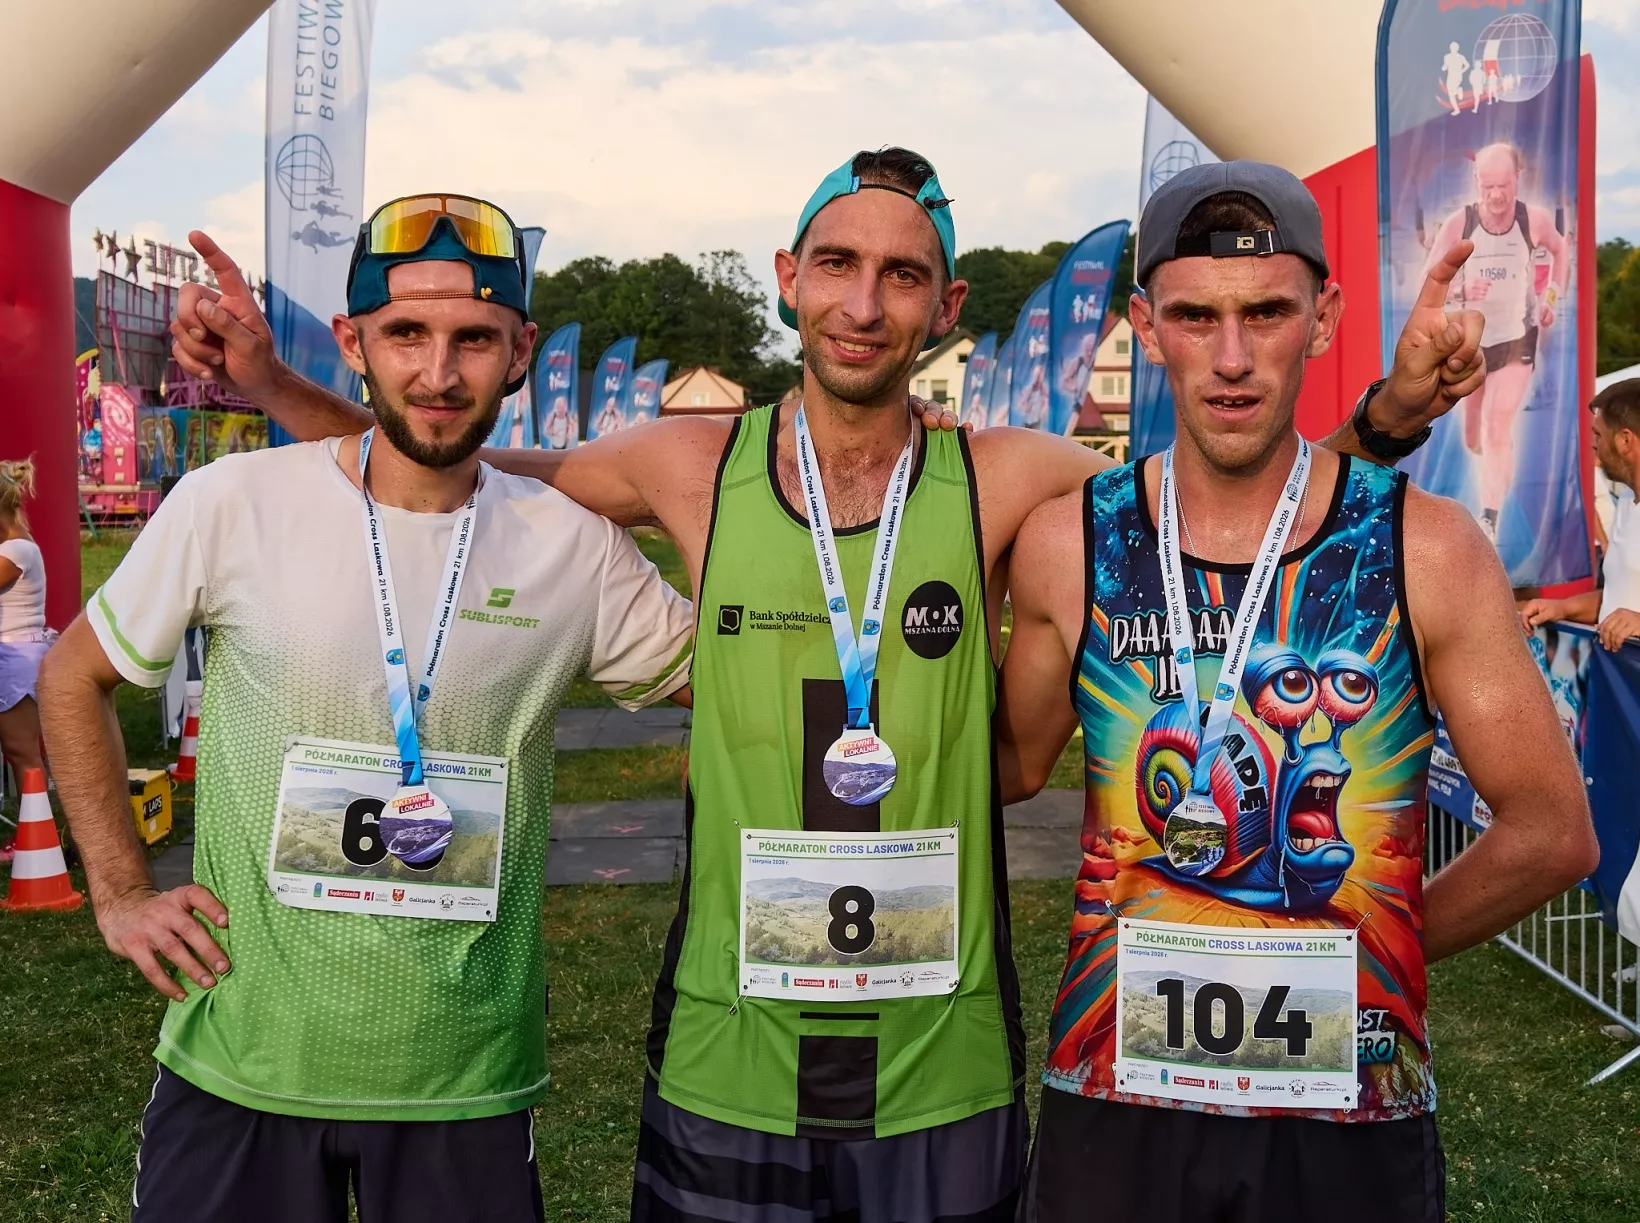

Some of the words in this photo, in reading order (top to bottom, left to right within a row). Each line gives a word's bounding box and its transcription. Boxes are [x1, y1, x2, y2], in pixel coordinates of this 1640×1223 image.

[294, 0, 319, 115] FESTIW
[806, 476, 815, 495] Cross
[810, 496, 822, 528] Laskowa
[886, 505, 898, 537] Laskowa
[369, 518, 378, 540] Cross
[456, 548, 464, 559] km
[819, 539, 827, 551] km
[881, 540, 892, 561] Cross
[373, 543, 383, 576] Laskowa
[453, 560, 461, 569] 21
[1164, 541, 1173, 575] Laskowa
[445, 571, 459, 604] Laskowa
[872, 562, 887, 610] Półmaraton
[1168, 577, 1175, 585] 21
[380, 588, 388, 601] km
[1169, 587, 1176, 599] km
[439, 606, 450, 628] Cross
[459, 608, 540, 628] SUBLISPORT
[749, 610, 774, 620] Bank
[776, 610, 831, 625] Spółdzielcz
[1228, 626, 1249, 675] Półmaraton
[1244, 600, 1258, 624] Cross
[1252, 565, 1270, 599] Laskowa
[1264, 554, 1273, 564] 21
[1271, 542, 1279, 554] km
[756, 622, 783, 630] Mszanie
[784, 623, 806, 632] Dolnej
[904, 627, 936, 635] MSZANA
[937, 626, 960, 634] DOLNA
[426, 629, 444, 677] Półmaraton
[838, 738, 873, 751] AKTYWNI
[845, 744, 878, 757] LOKALNIE
[304, 749, 380, 767] PÓŁMARATON
[383, 758, 403, 770] CRO
[468, 766, 477, 776] 21
[478, 767, 492, 777] KM
[393, 794, 427, 807] AKTYWNI
[400, 801, 433, 813] LOKALNIE
[341, 796, 446, 873] 6
[758, 841, 827, 854] PÓŁMARATON
[829, 844, 864, 854] CROSS
[867, 842, 914, 854] LASKOWA
[916, 842, 925, 851] 21
[927, 841, 941, 850] KM
[827, 884, 876, 955] 8
[1136, 931, 1206, 948] PÓŁMARATON
[1208, 939, 1245, 950] CROSS
[1248, 941, 1303, 952] LASKOWA
[1305, 942, 1317, 951] 21
[1319, 942, 1336, 951] KM
[1129, 948, 1150, 956] sierpnia
[1156, 978, 1313, 1057] 104
[1255, 1084, 1285, 1092] Galicjanka
